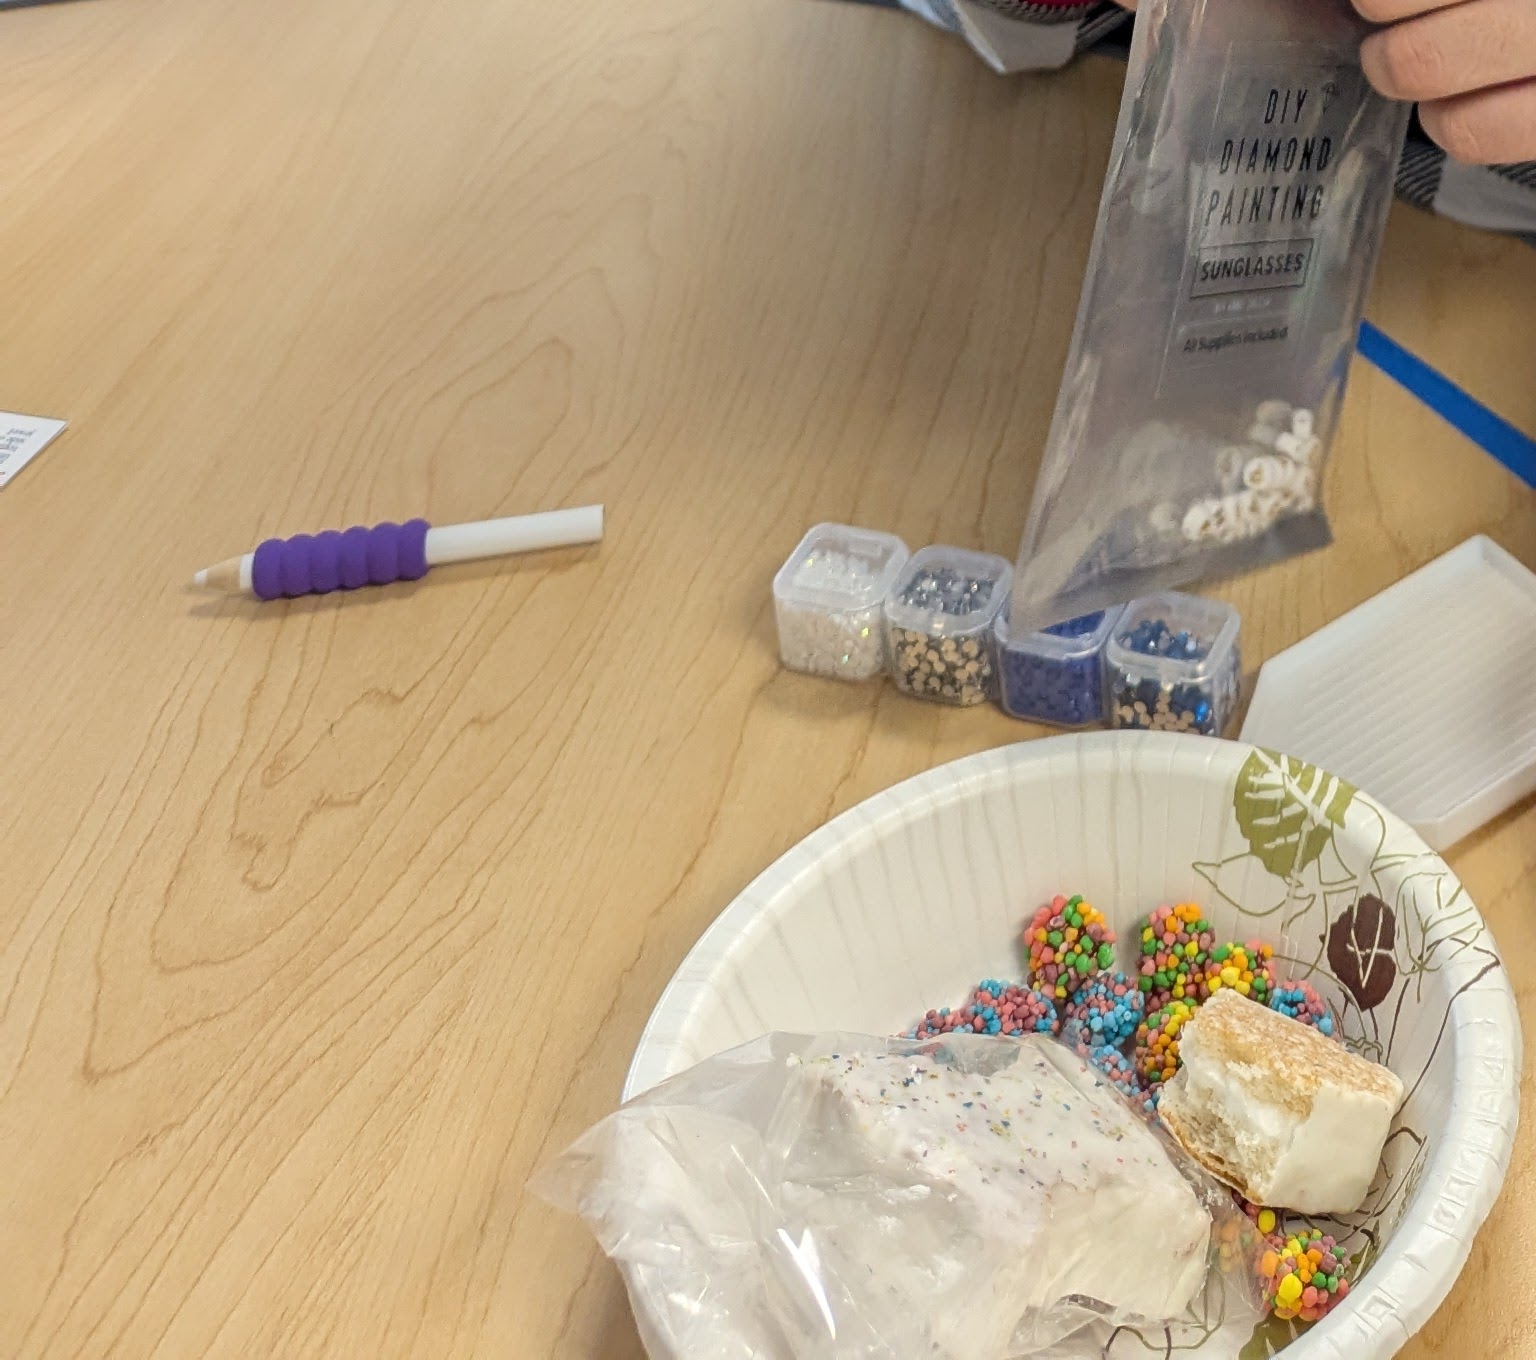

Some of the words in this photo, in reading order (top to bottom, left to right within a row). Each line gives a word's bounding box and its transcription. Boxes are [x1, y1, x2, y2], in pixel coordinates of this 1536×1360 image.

[1264, 89, 1308, 124] DIY
[1219, 136, 1331, 174] DIAMOND
[1204, 184, 1323, 227] PAINTING
[1201, 253, 1305, 282] SUNGLASSES
[1184, 337, 1198, 353] All
